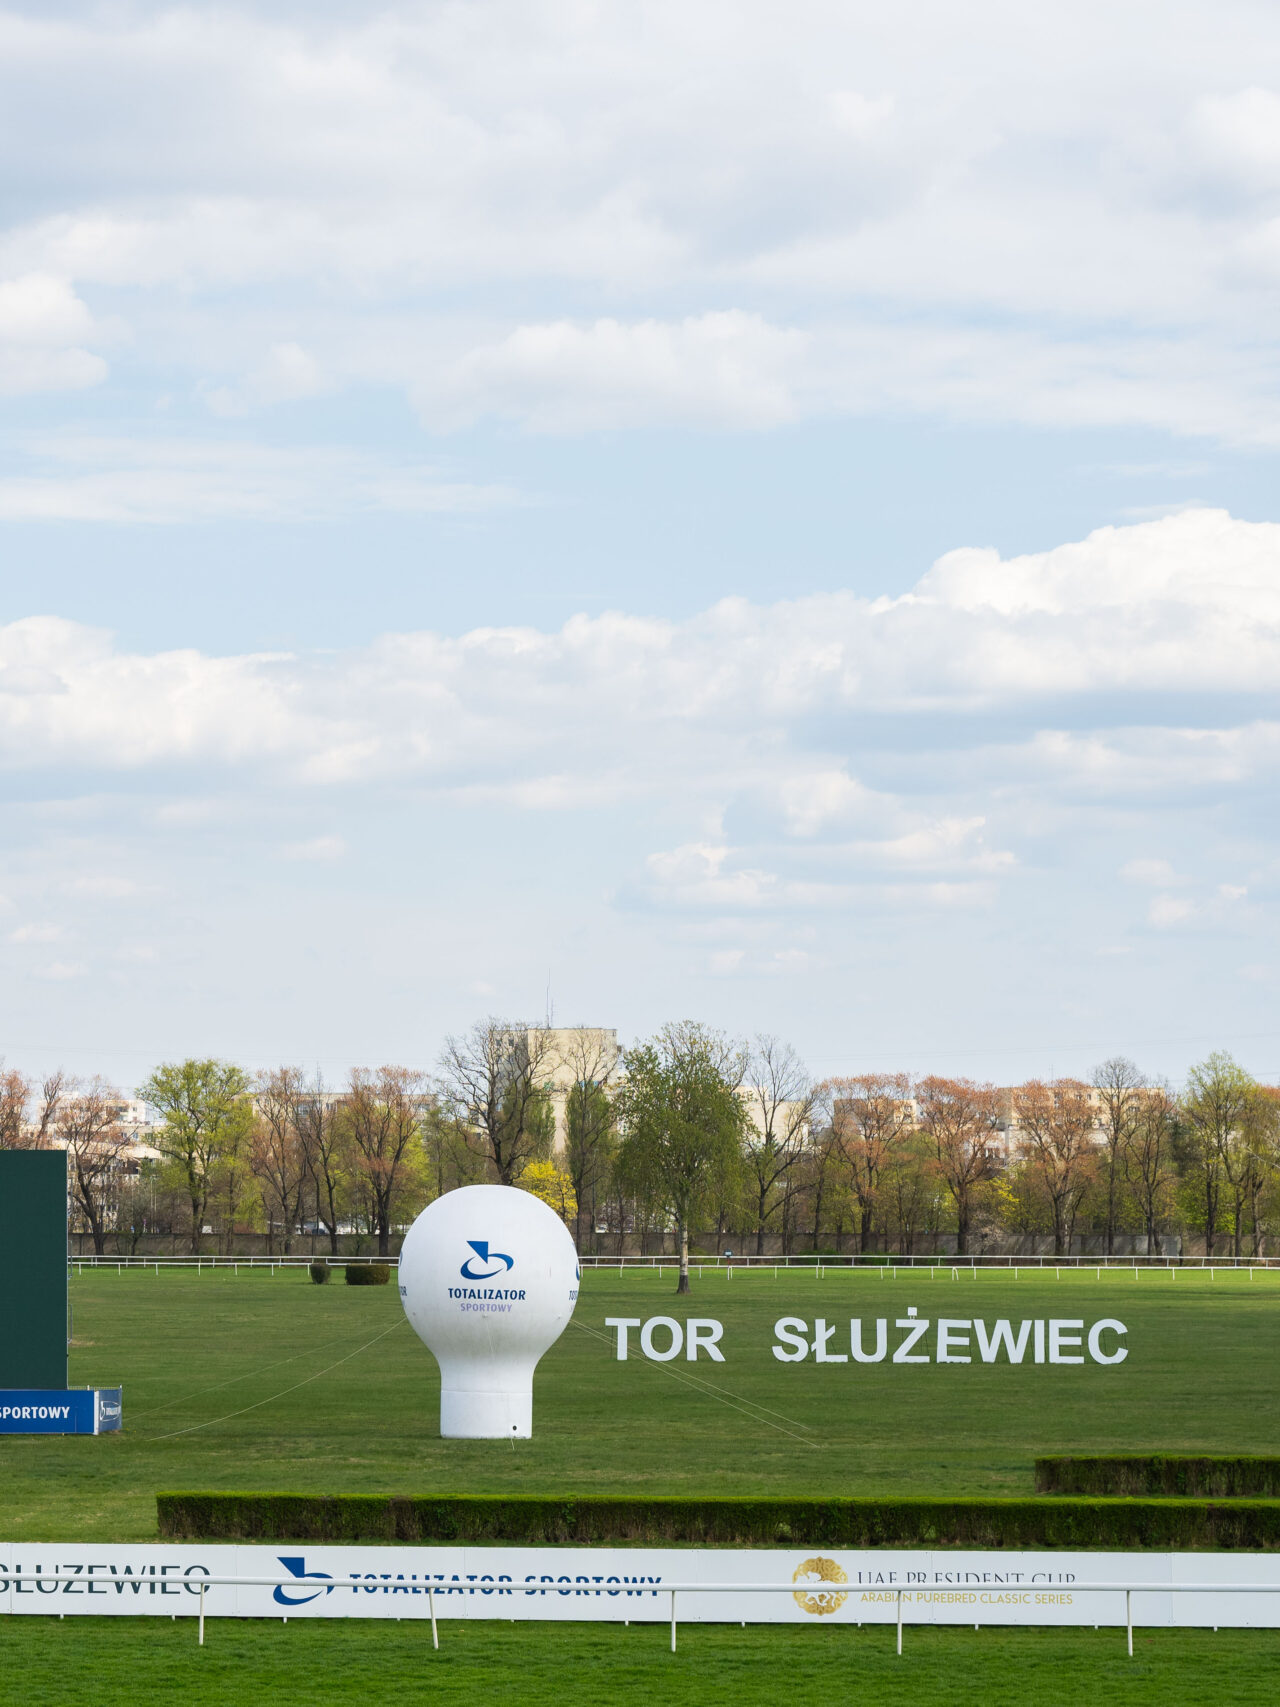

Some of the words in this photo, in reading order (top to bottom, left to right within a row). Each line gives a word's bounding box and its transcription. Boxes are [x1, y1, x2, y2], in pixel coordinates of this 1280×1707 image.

[448, 1288, 526, 1300] TOTALIZATOR
[460, 1303, 512, 1312] SPORTOWY
[605, 1316, 725, 1362] TOR
[772, 1307, 1129, 1365] SŁUŻEWIEC
[349, 1574, 513, 1595] TOTALIZATOR
[524, 1576, 662, 1597] SPORTOWY
[861, 1592, 912, 1603] ARABIAN
[916, 1592, 977, 1604] PUREBRED
[980, 1593, 1030, 1605] CLASSIC
[1035, 1594, 1073, 1605] SERIES
